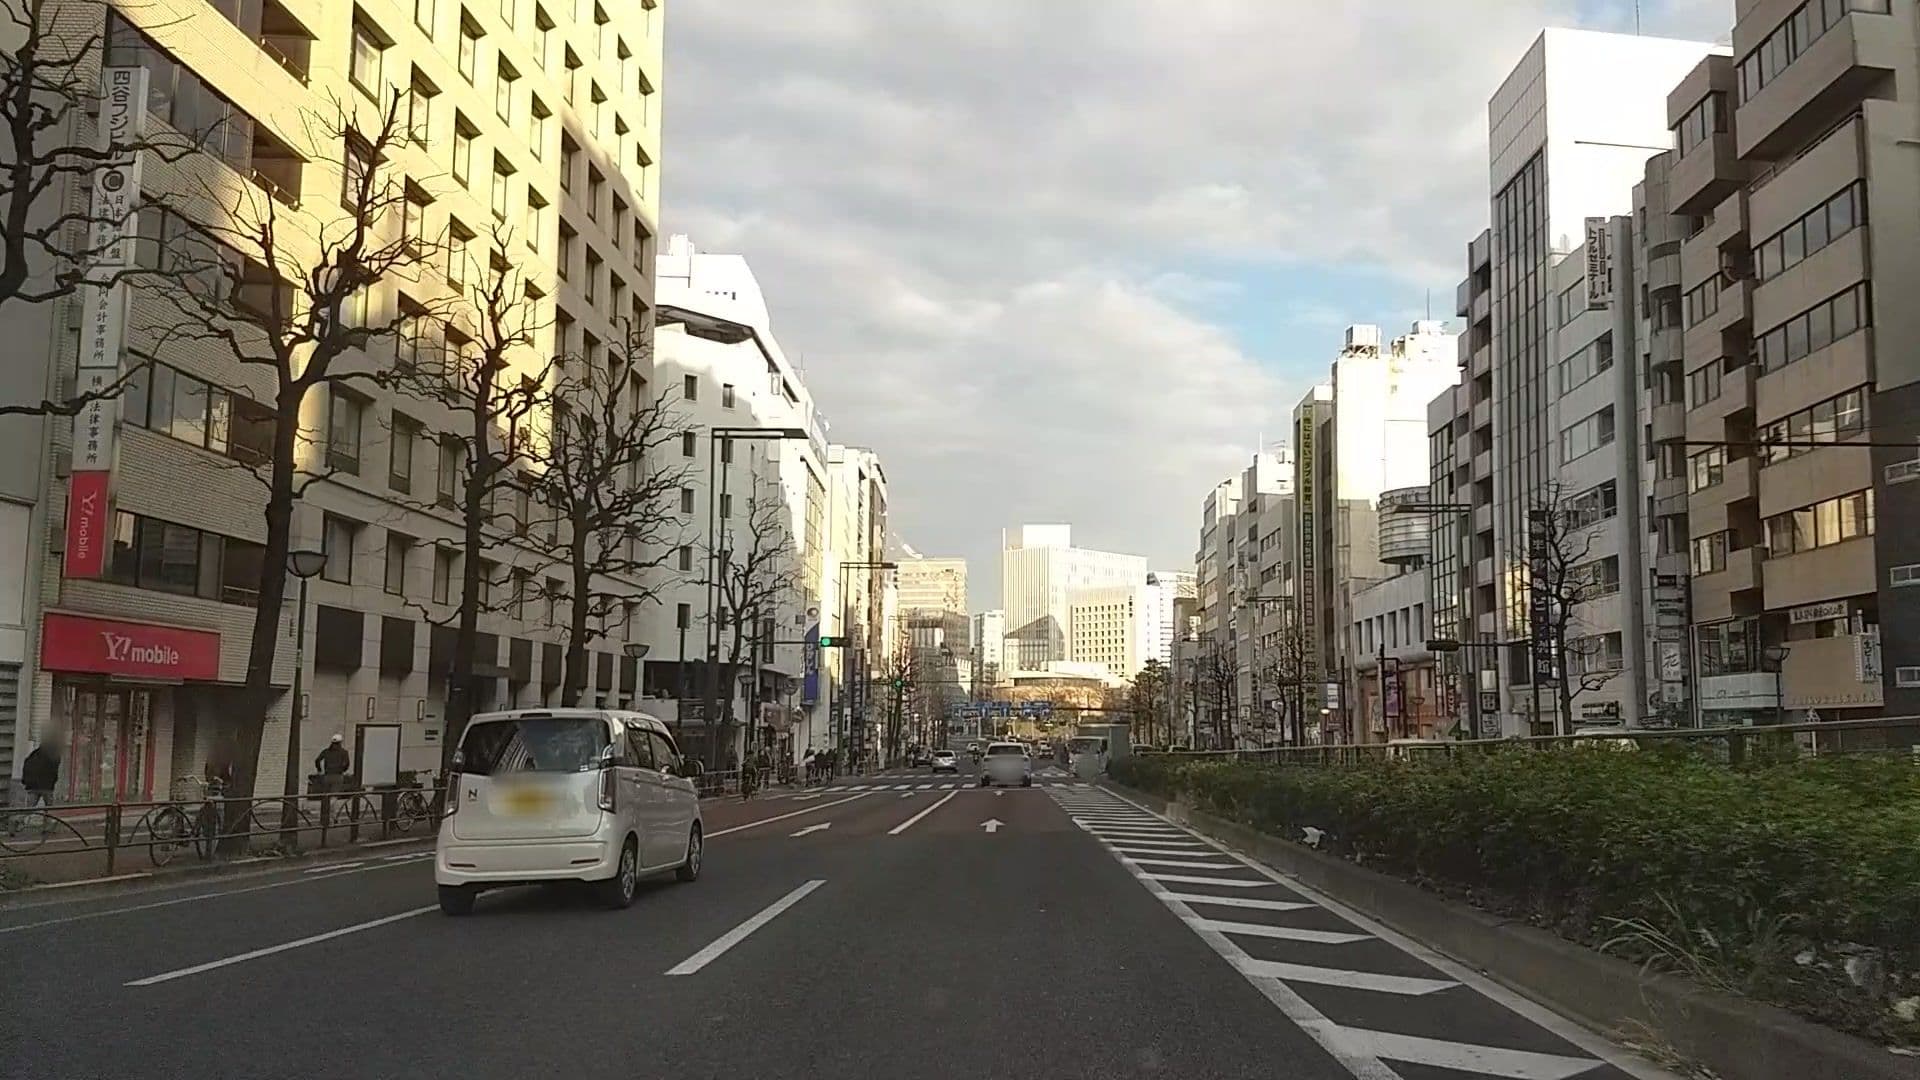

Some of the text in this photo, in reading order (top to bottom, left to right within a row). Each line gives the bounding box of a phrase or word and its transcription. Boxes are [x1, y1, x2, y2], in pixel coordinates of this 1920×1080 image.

[86, 375, 103, 465] 横法律事務所
[78, 488, 98, 559] Y!mobile
[101, 631, 179, 665] Y!mobile
[468, 788, 478, 799] N
